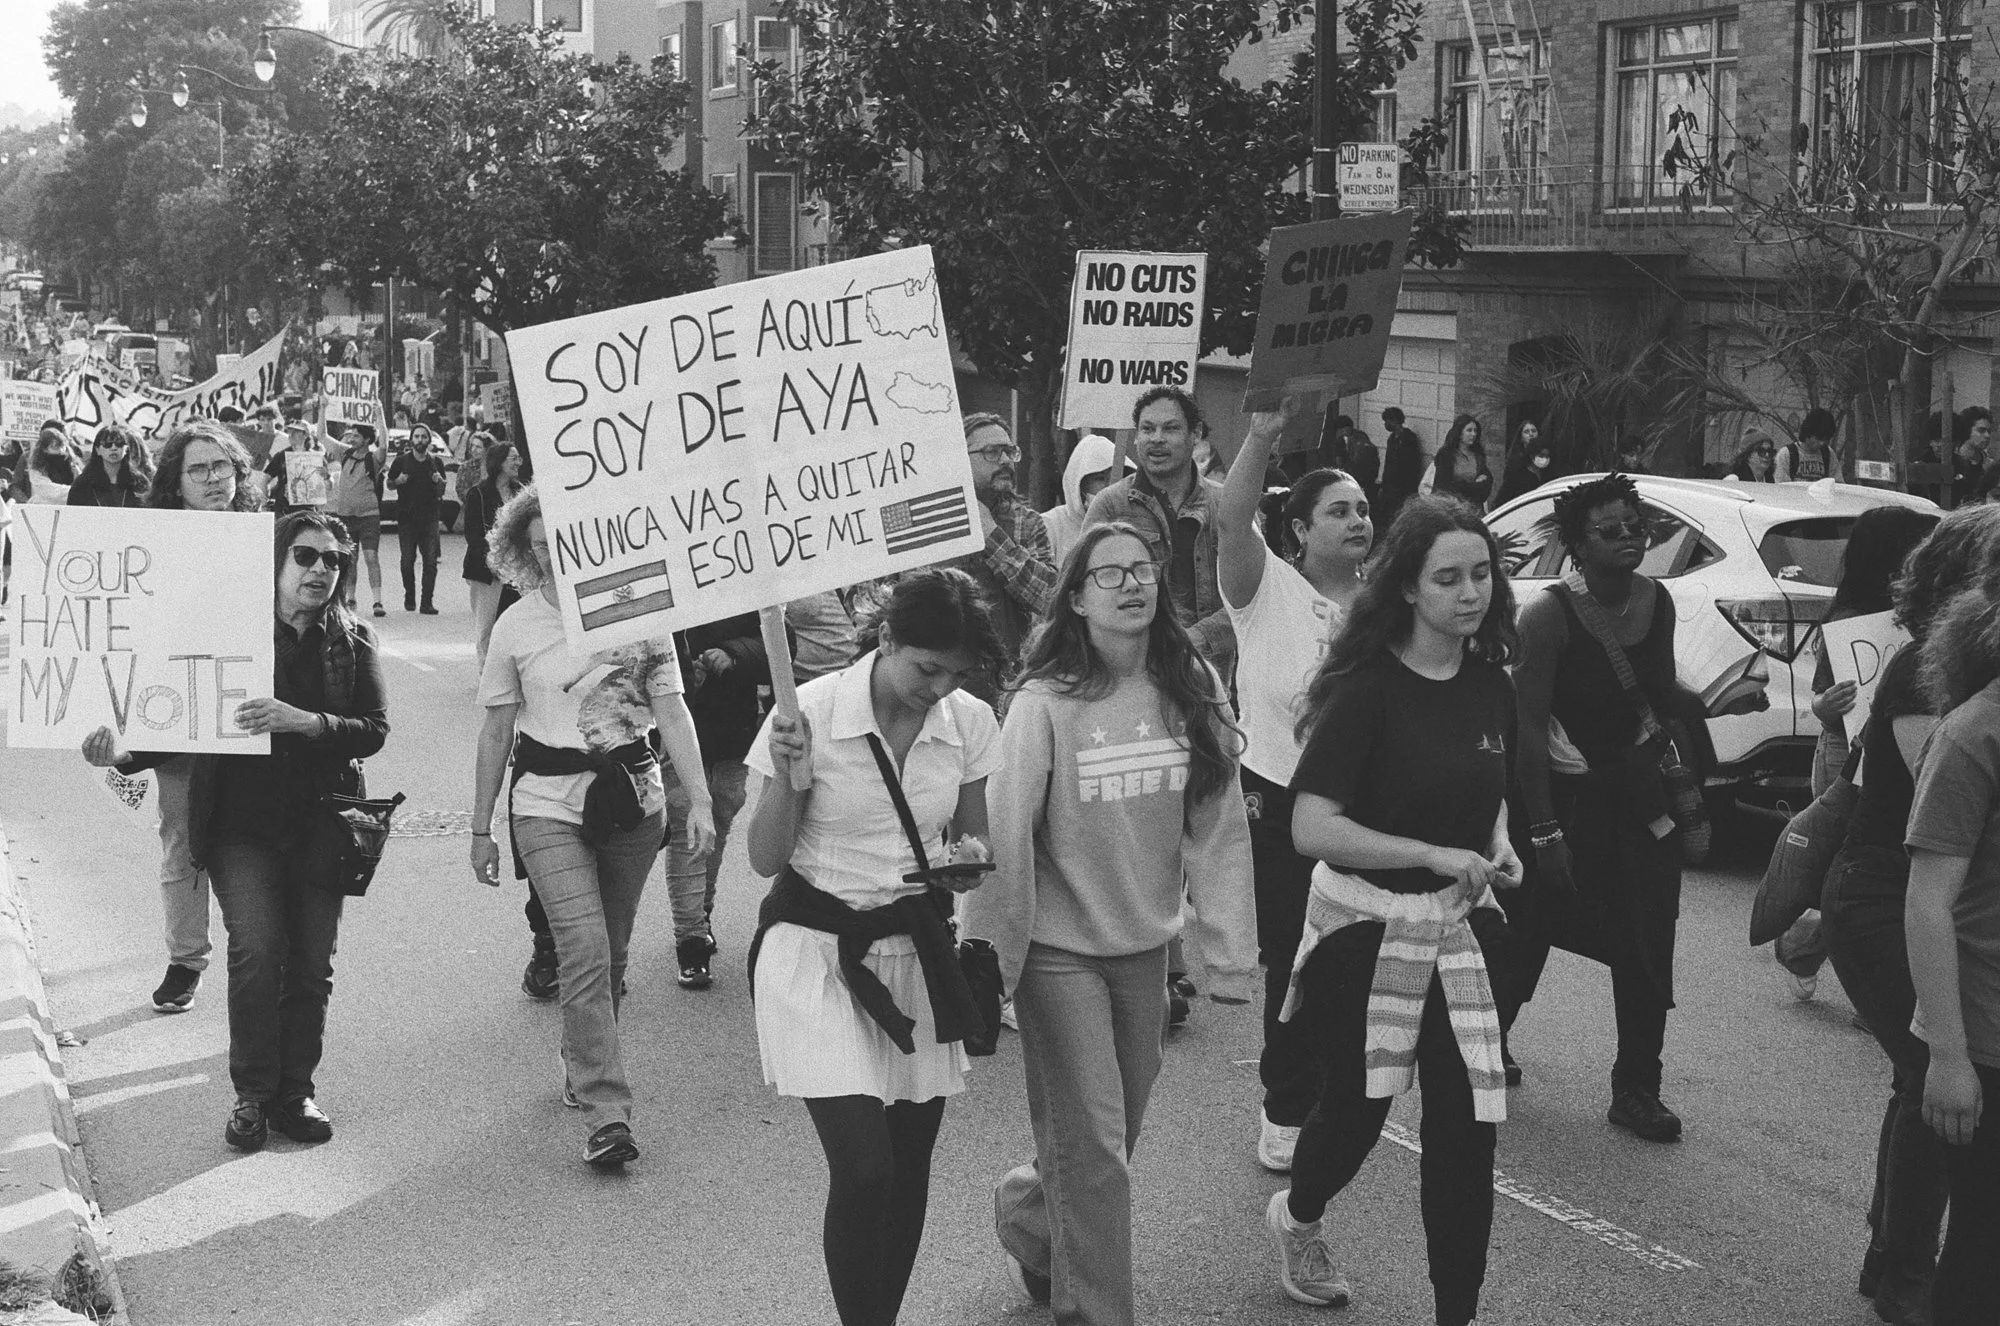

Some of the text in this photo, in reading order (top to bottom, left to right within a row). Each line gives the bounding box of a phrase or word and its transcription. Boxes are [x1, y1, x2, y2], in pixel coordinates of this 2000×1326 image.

[1341, 145, 1397, 162] NO PARKING
[1342, 184, 1395, 195] WEDNESDAY
[1085, 262, 1197, 294] NO CUTS
[1281, 239, 1394, 286] CHINGA
[1082, 299, 1195, 328] NO RAIDS
[1307, 282, 1349, 314] LA
[545, 324, 649, 413] SOY
[669, 304, 738, 373] DE
[756, 278, 864, 358] AQUÍ
[1270, 313, 1374, 349] MIGRA
[324, 372, 378, 400] CHINGA
[1078, 358, 1190, 386] NO WARS
[553, 400, 653, 491] SOY
[677, 379, 746, 454] DE
[773, 362, 879, 442] AYA
[555, 441, 918, 575] NUNCA VAS A QUITAR
[21, 509, 154, 597] YOUR
[687, 508, 874, 589] ESO DE MI
[21, 594, 133, 652] HATE
[19, 656, 79, 726] MY
[1078, 765, 1189, 803] FREE D
